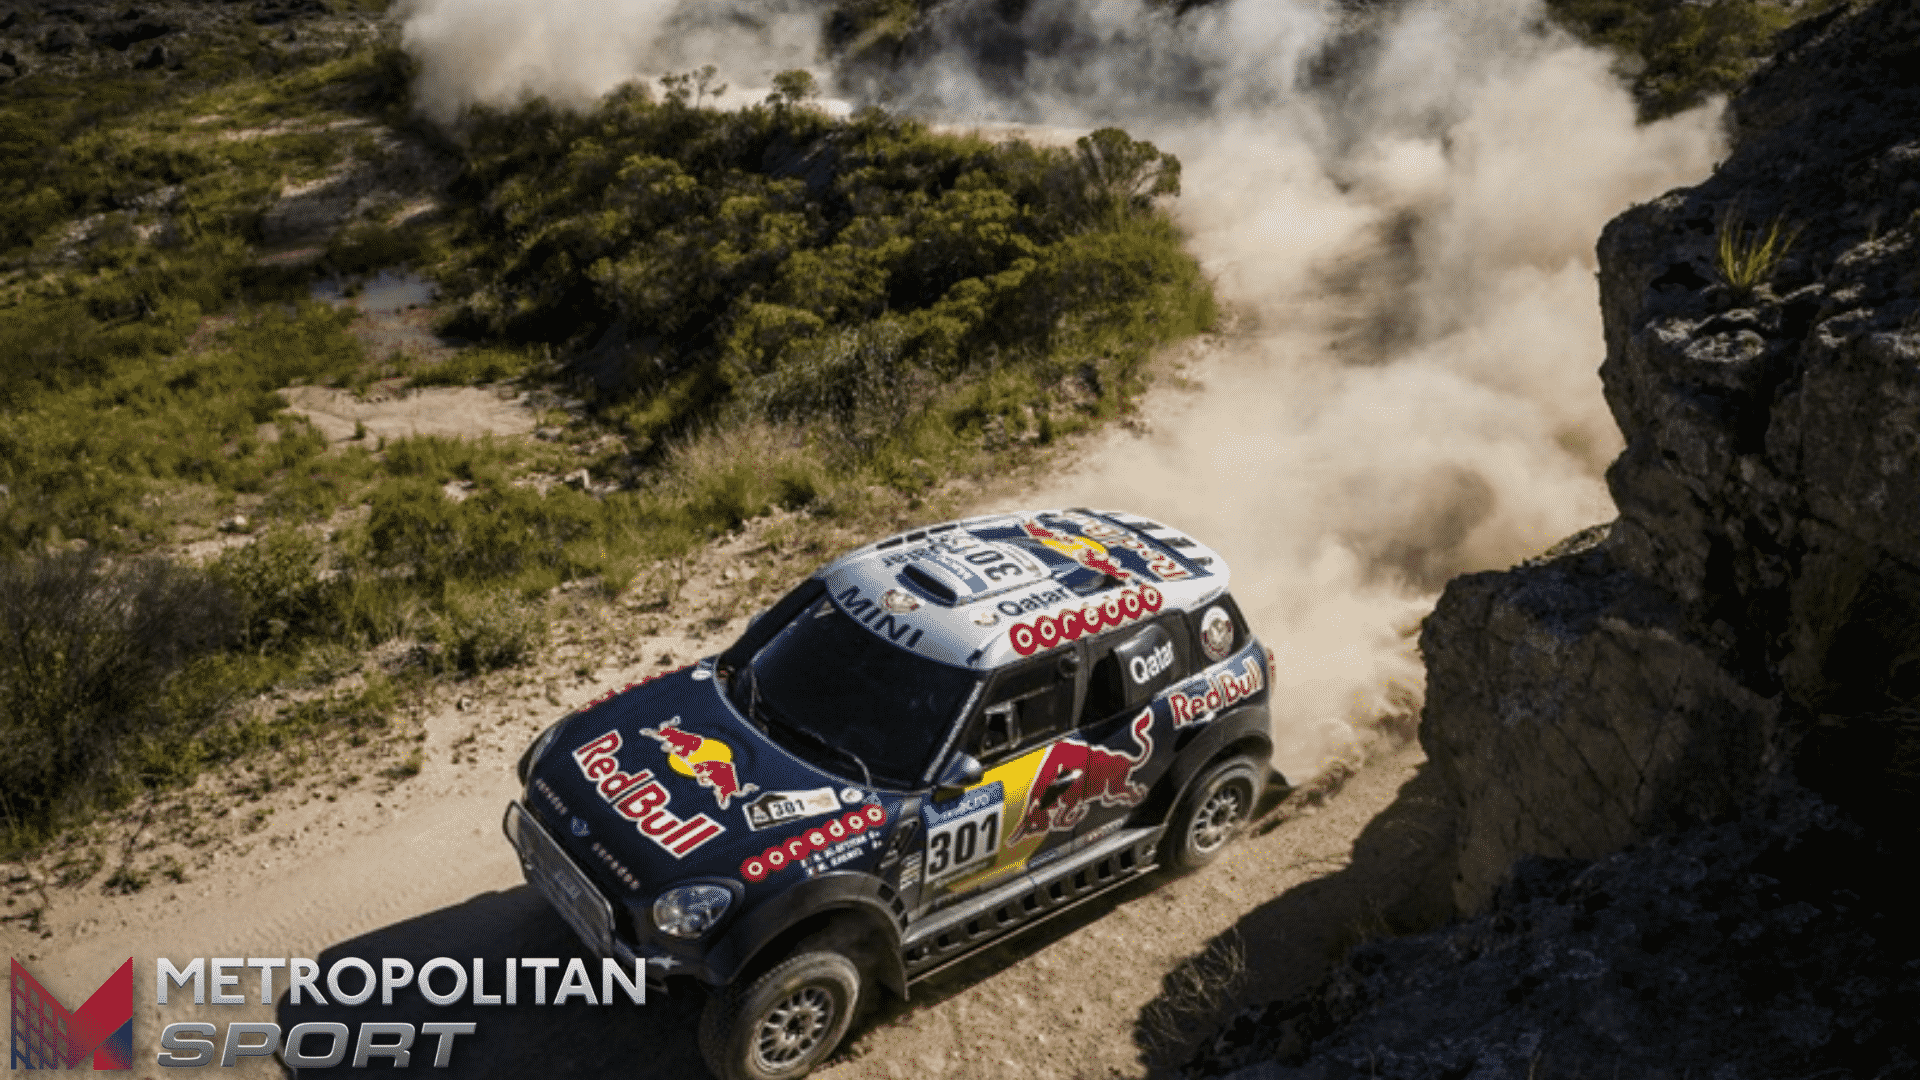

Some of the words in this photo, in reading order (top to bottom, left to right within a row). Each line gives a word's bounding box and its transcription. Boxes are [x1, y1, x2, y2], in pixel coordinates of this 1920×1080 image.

[836, 584, 924, 648] MINI
[997, 588, 1069, 616] Qatar
[1013, 585, 1161, 651] ooredoo
[1130, 640, 1174, 684] Qatar
[1168, 679, 1223, 730] Red
[1219, 656, 1264, 707] Bull
[572, 730, 655, 803] Red
[612, 780, 726, 858] Bull
[773, 799, 805, 817] 301
[744, 805, 885, 879] ooredoo
[928, 811, 999, 876] 301
